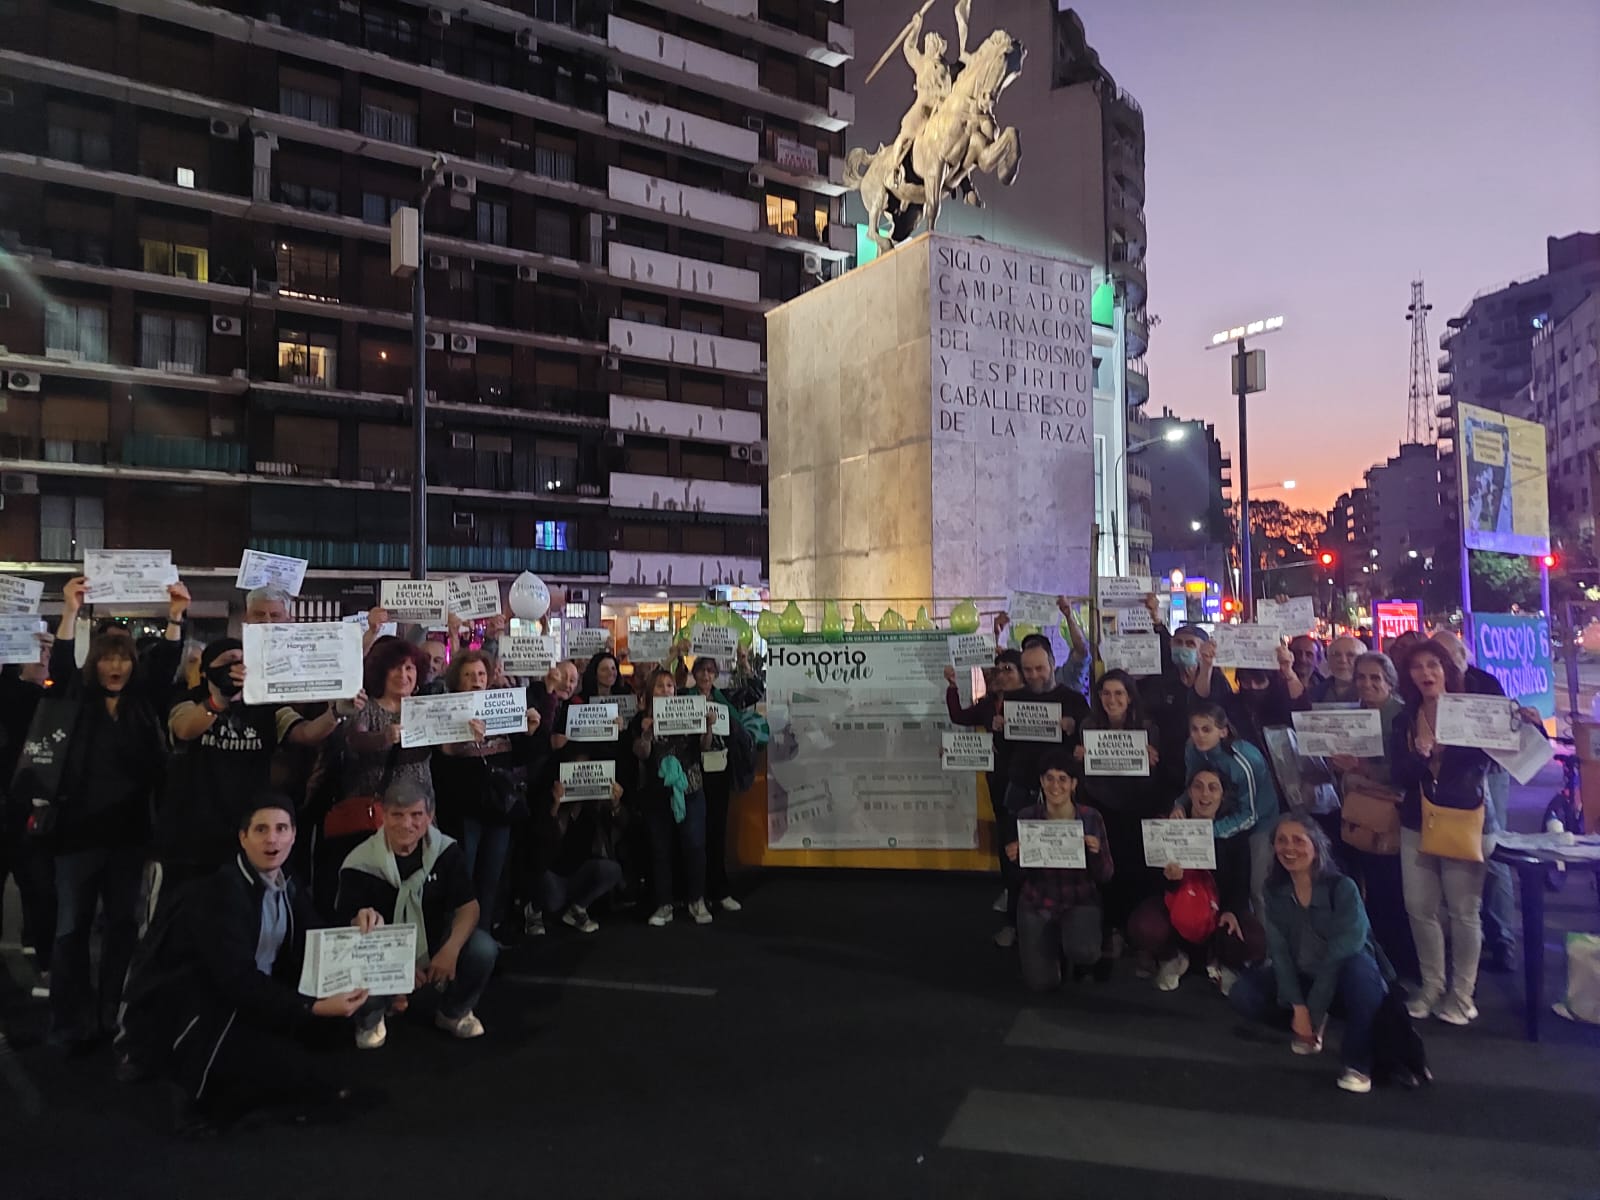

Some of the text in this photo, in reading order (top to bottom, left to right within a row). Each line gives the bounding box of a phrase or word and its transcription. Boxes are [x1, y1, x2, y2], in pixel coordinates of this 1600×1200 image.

[938, 247, 1084, 293] SIGLO XI EL CID
[939, 273, 1085, 320] CAMPEADOR
[939, 300, 1086, 343] ENCARNACION
[940, 328, 1085, 369] DEL HEROISMO
[940, 355, 1086, 393] Y ESPIRITU
[940, 383, 1086, 418] CABALLERESCO
[940, 410, 1086, 444] DE LA RAZA
[449, 592, 471, 601] CINOS
[768, 646, 866, 667] Honorio
[1481, 623, 1536, 662] Consejo
[484, 698, 515, 707] ESCUCHÁ
